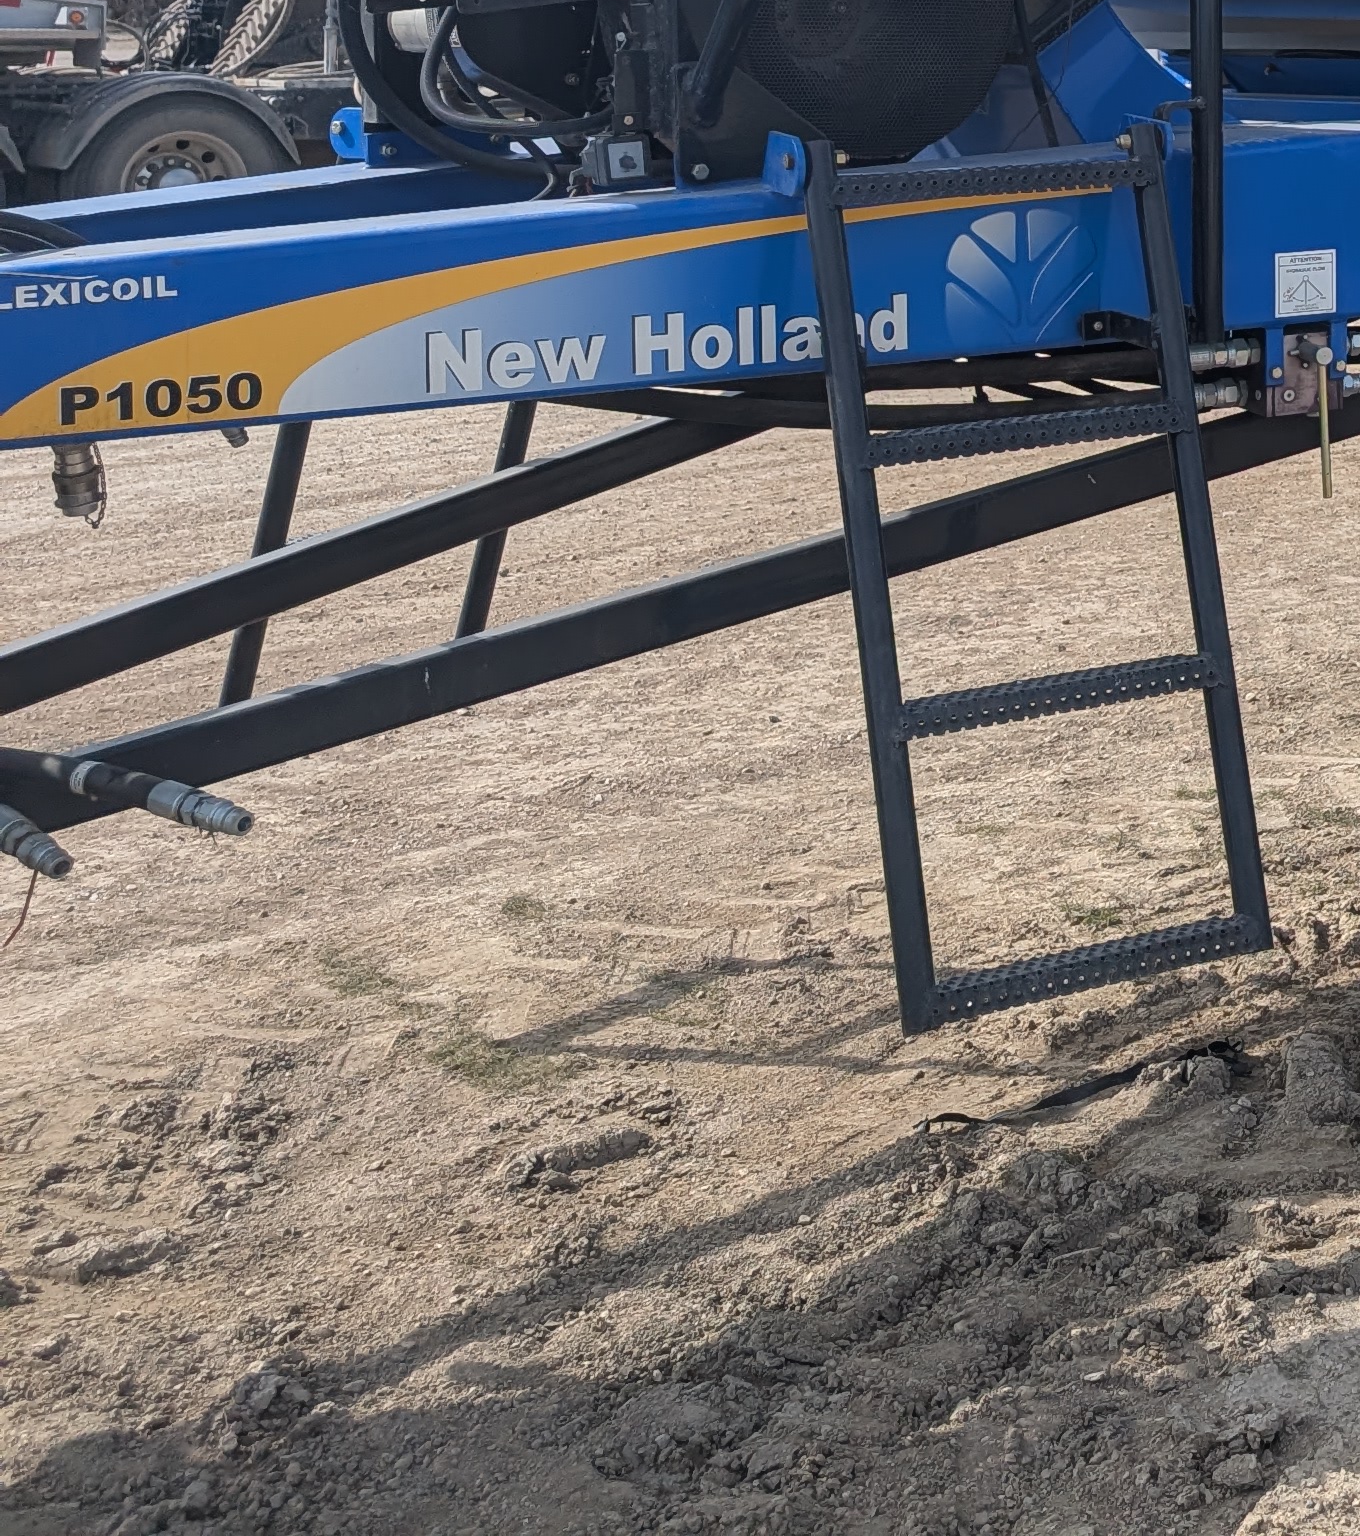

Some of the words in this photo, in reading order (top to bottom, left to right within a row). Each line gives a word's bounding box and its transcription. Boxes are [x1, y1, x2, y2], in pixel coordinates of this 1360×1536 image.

[1289, 255, 1323, 264] ATTENTION
[425, 327, 607, 395] New
[631, 293, 909, 376] Hollad
[59, 371, 263, 426] P1050
